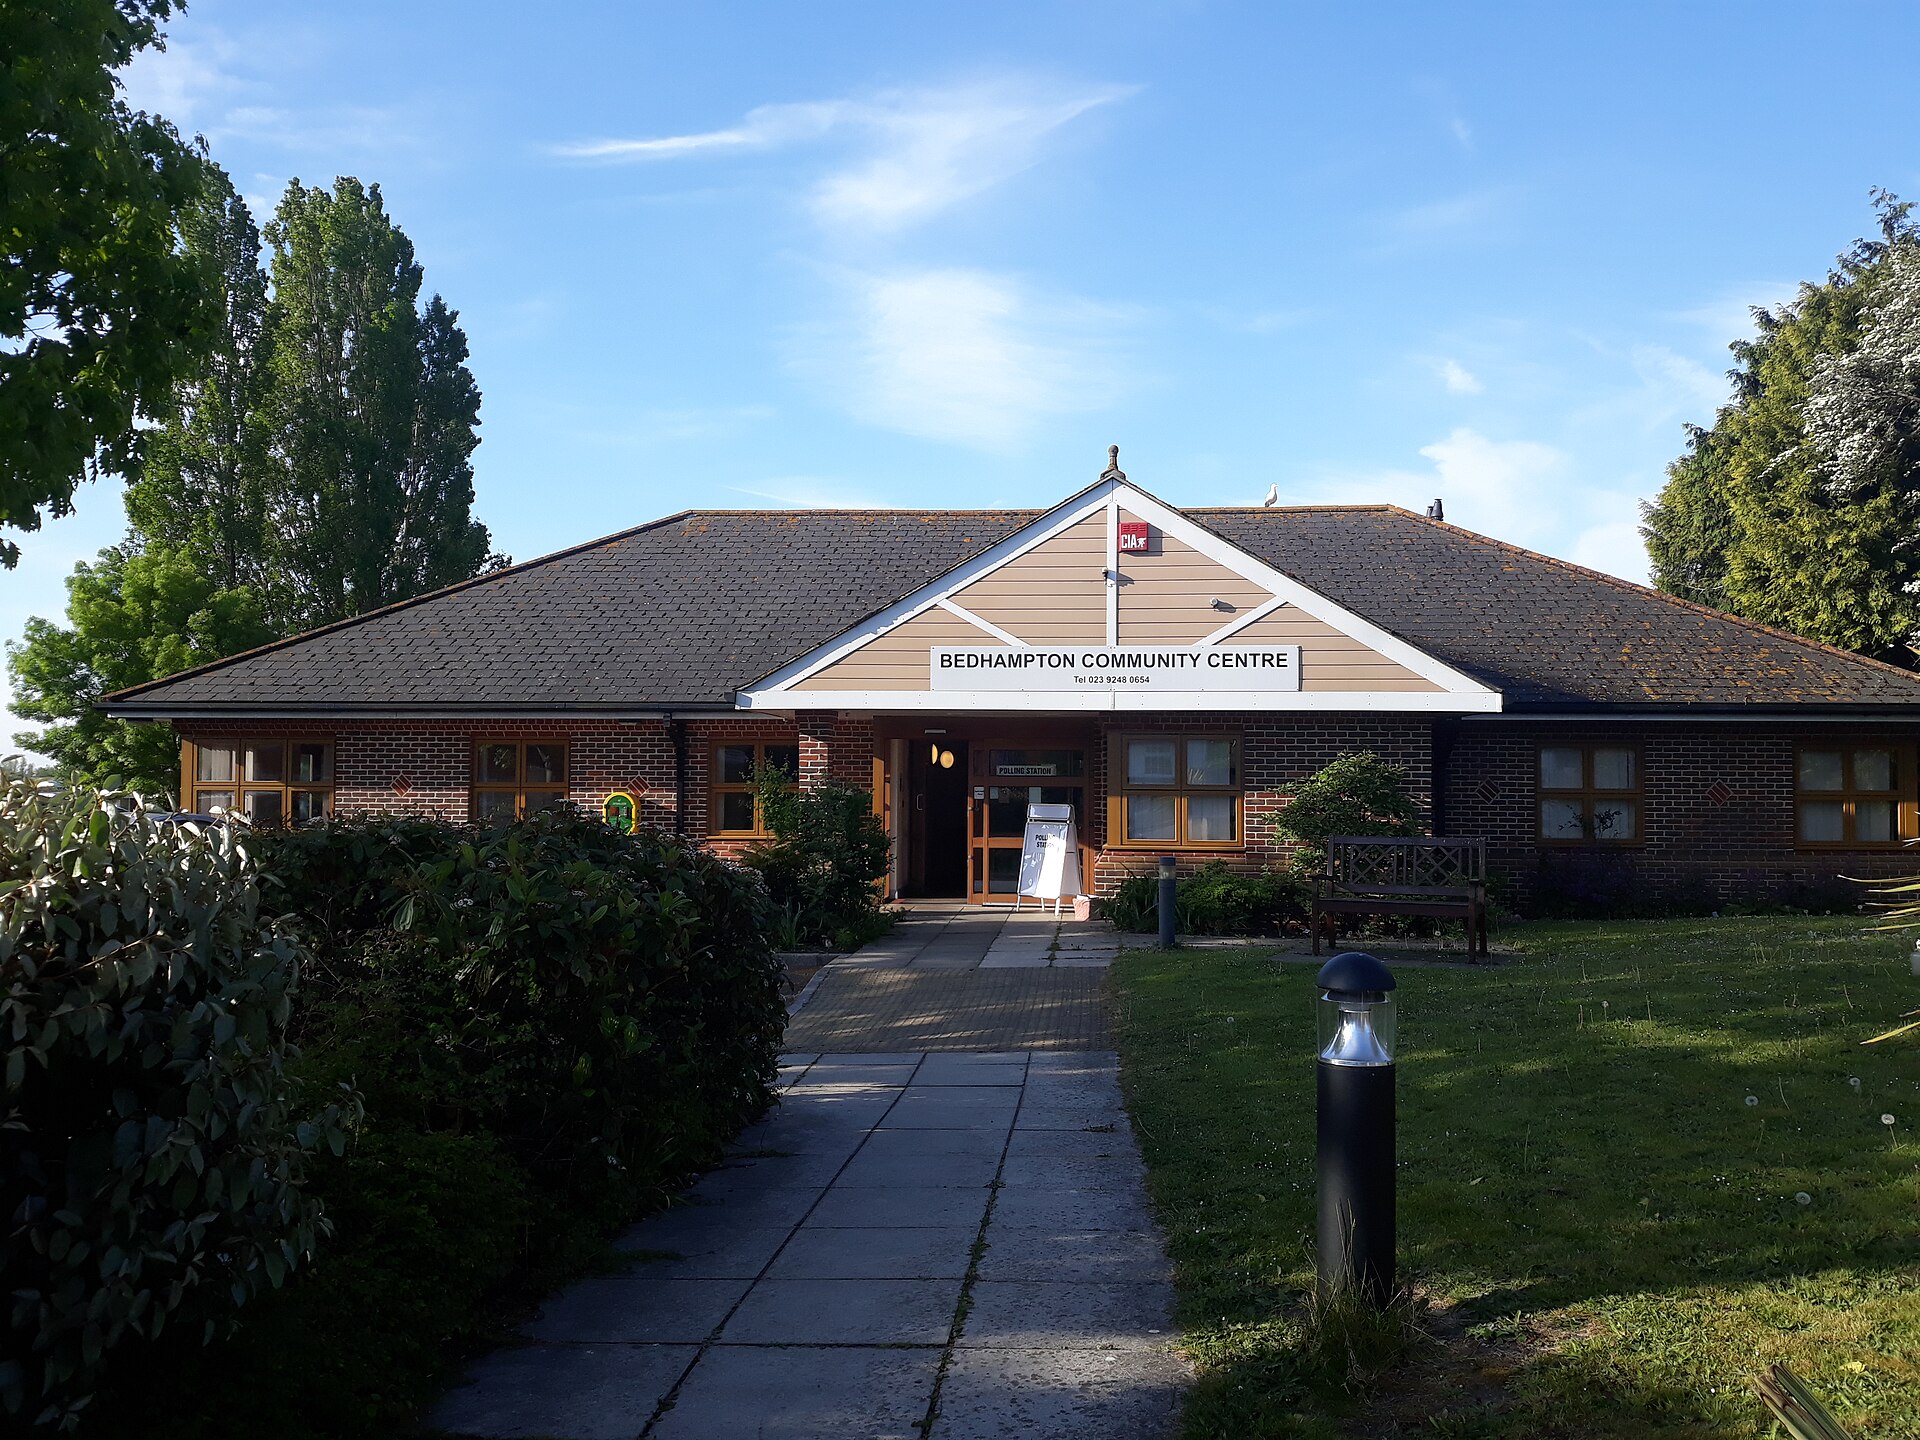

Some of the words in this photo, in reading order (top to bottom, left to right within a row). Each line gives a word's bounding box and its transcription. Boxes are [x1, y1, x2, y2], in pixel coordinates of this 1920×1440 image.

[1121, 534, 1137, 549] CIA
[940, 653, 1075, 669] BEDHAMPTON
[1081, 653, 1202, 669] COMMUNITY
[1207, 652, 1288, 668] CENTRE
[1074, 675, 1086, 683] Tel
[1088, 675, 1104, 684] 023
[1106, 675, 1127, 684] 9248
[1129, 675, 1150, 684] 0654
[999, 767, 1025, 775] POLLING
[1026, 767, 1052, 775] STATION
